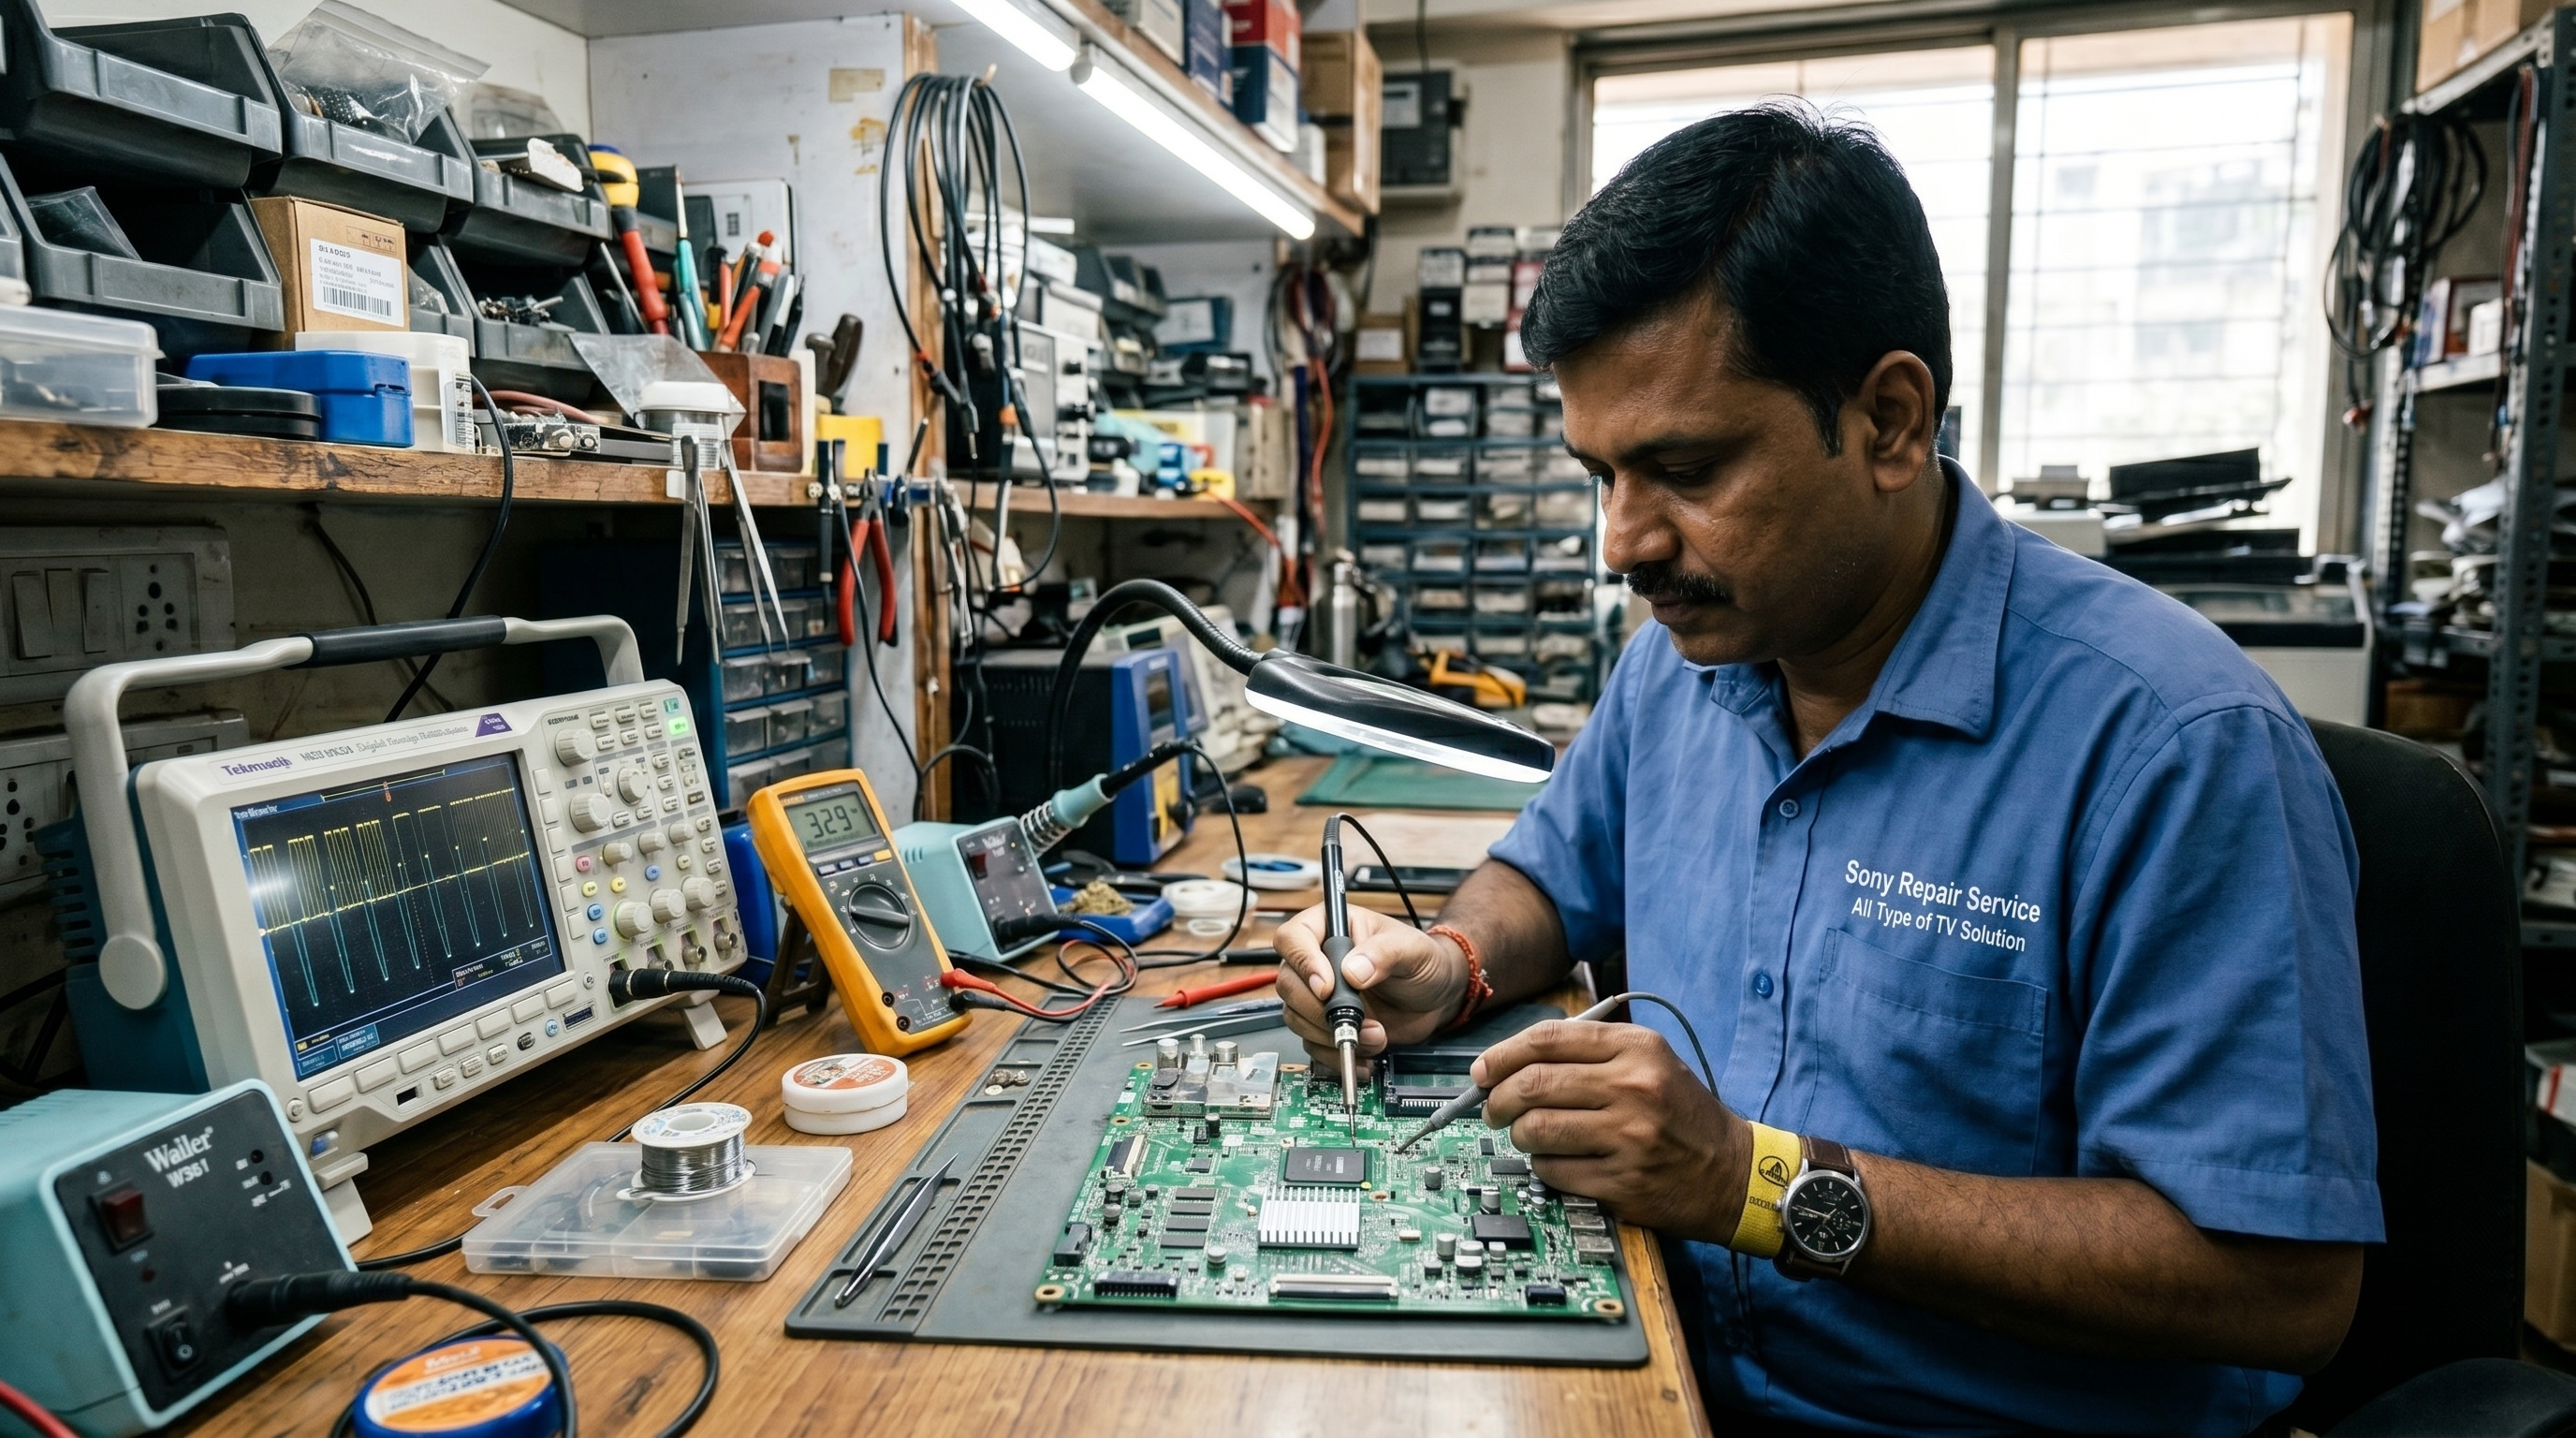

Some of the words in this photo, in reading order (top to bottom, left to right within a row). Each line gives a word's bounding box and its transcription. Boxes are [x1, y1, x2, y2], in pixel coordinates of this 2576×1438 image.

[1845, 859, 1895, 897] Sony
[1898, 871, 1963, 906] Repair
[1967, 886, 2041, 923] Service
[1851, 897, 1873, 917] All
[1877, 902, 1911, 928] Type
[1915, 913, 1933, 930] of
[1936, 914, 1957, 936] TV
[1960, 920, 2026, 952] Solution
